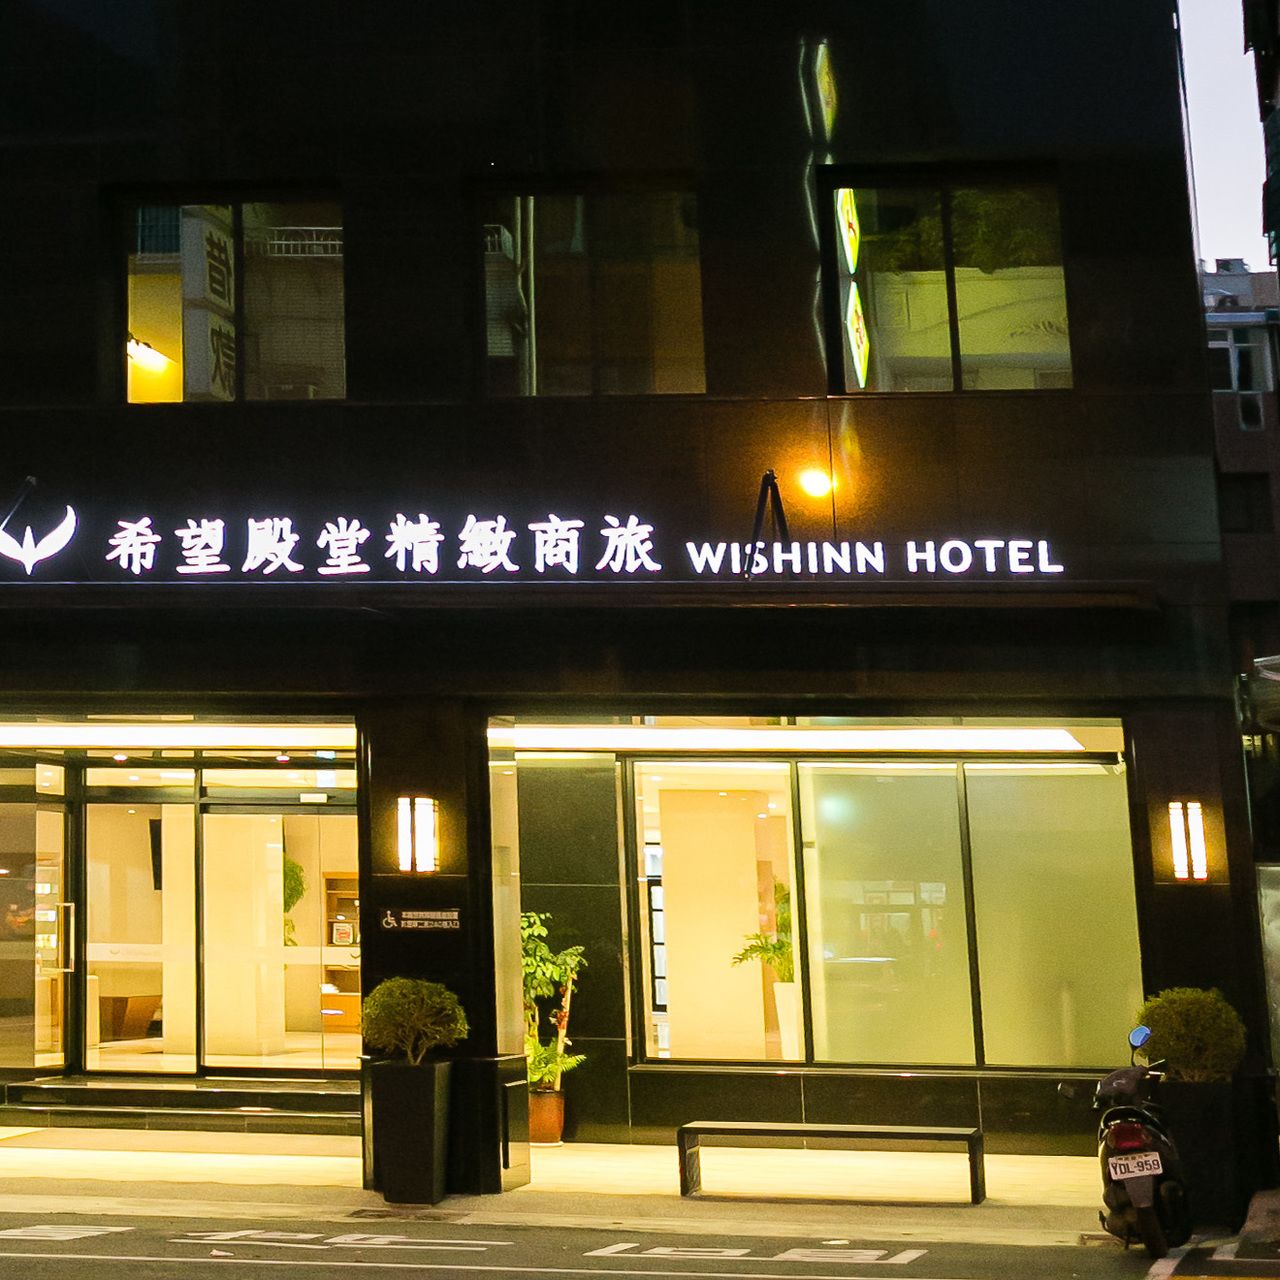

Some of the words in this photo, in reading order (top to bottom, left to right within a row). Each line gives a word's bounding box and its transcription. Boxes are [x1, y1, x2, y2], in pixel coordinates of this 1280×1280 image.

[105, 512, 663, 576] 希望殿堂精緻商旅
[685, 540, 886, 575] WISHINN
[906, 539, 1065, 574] HOTEL
